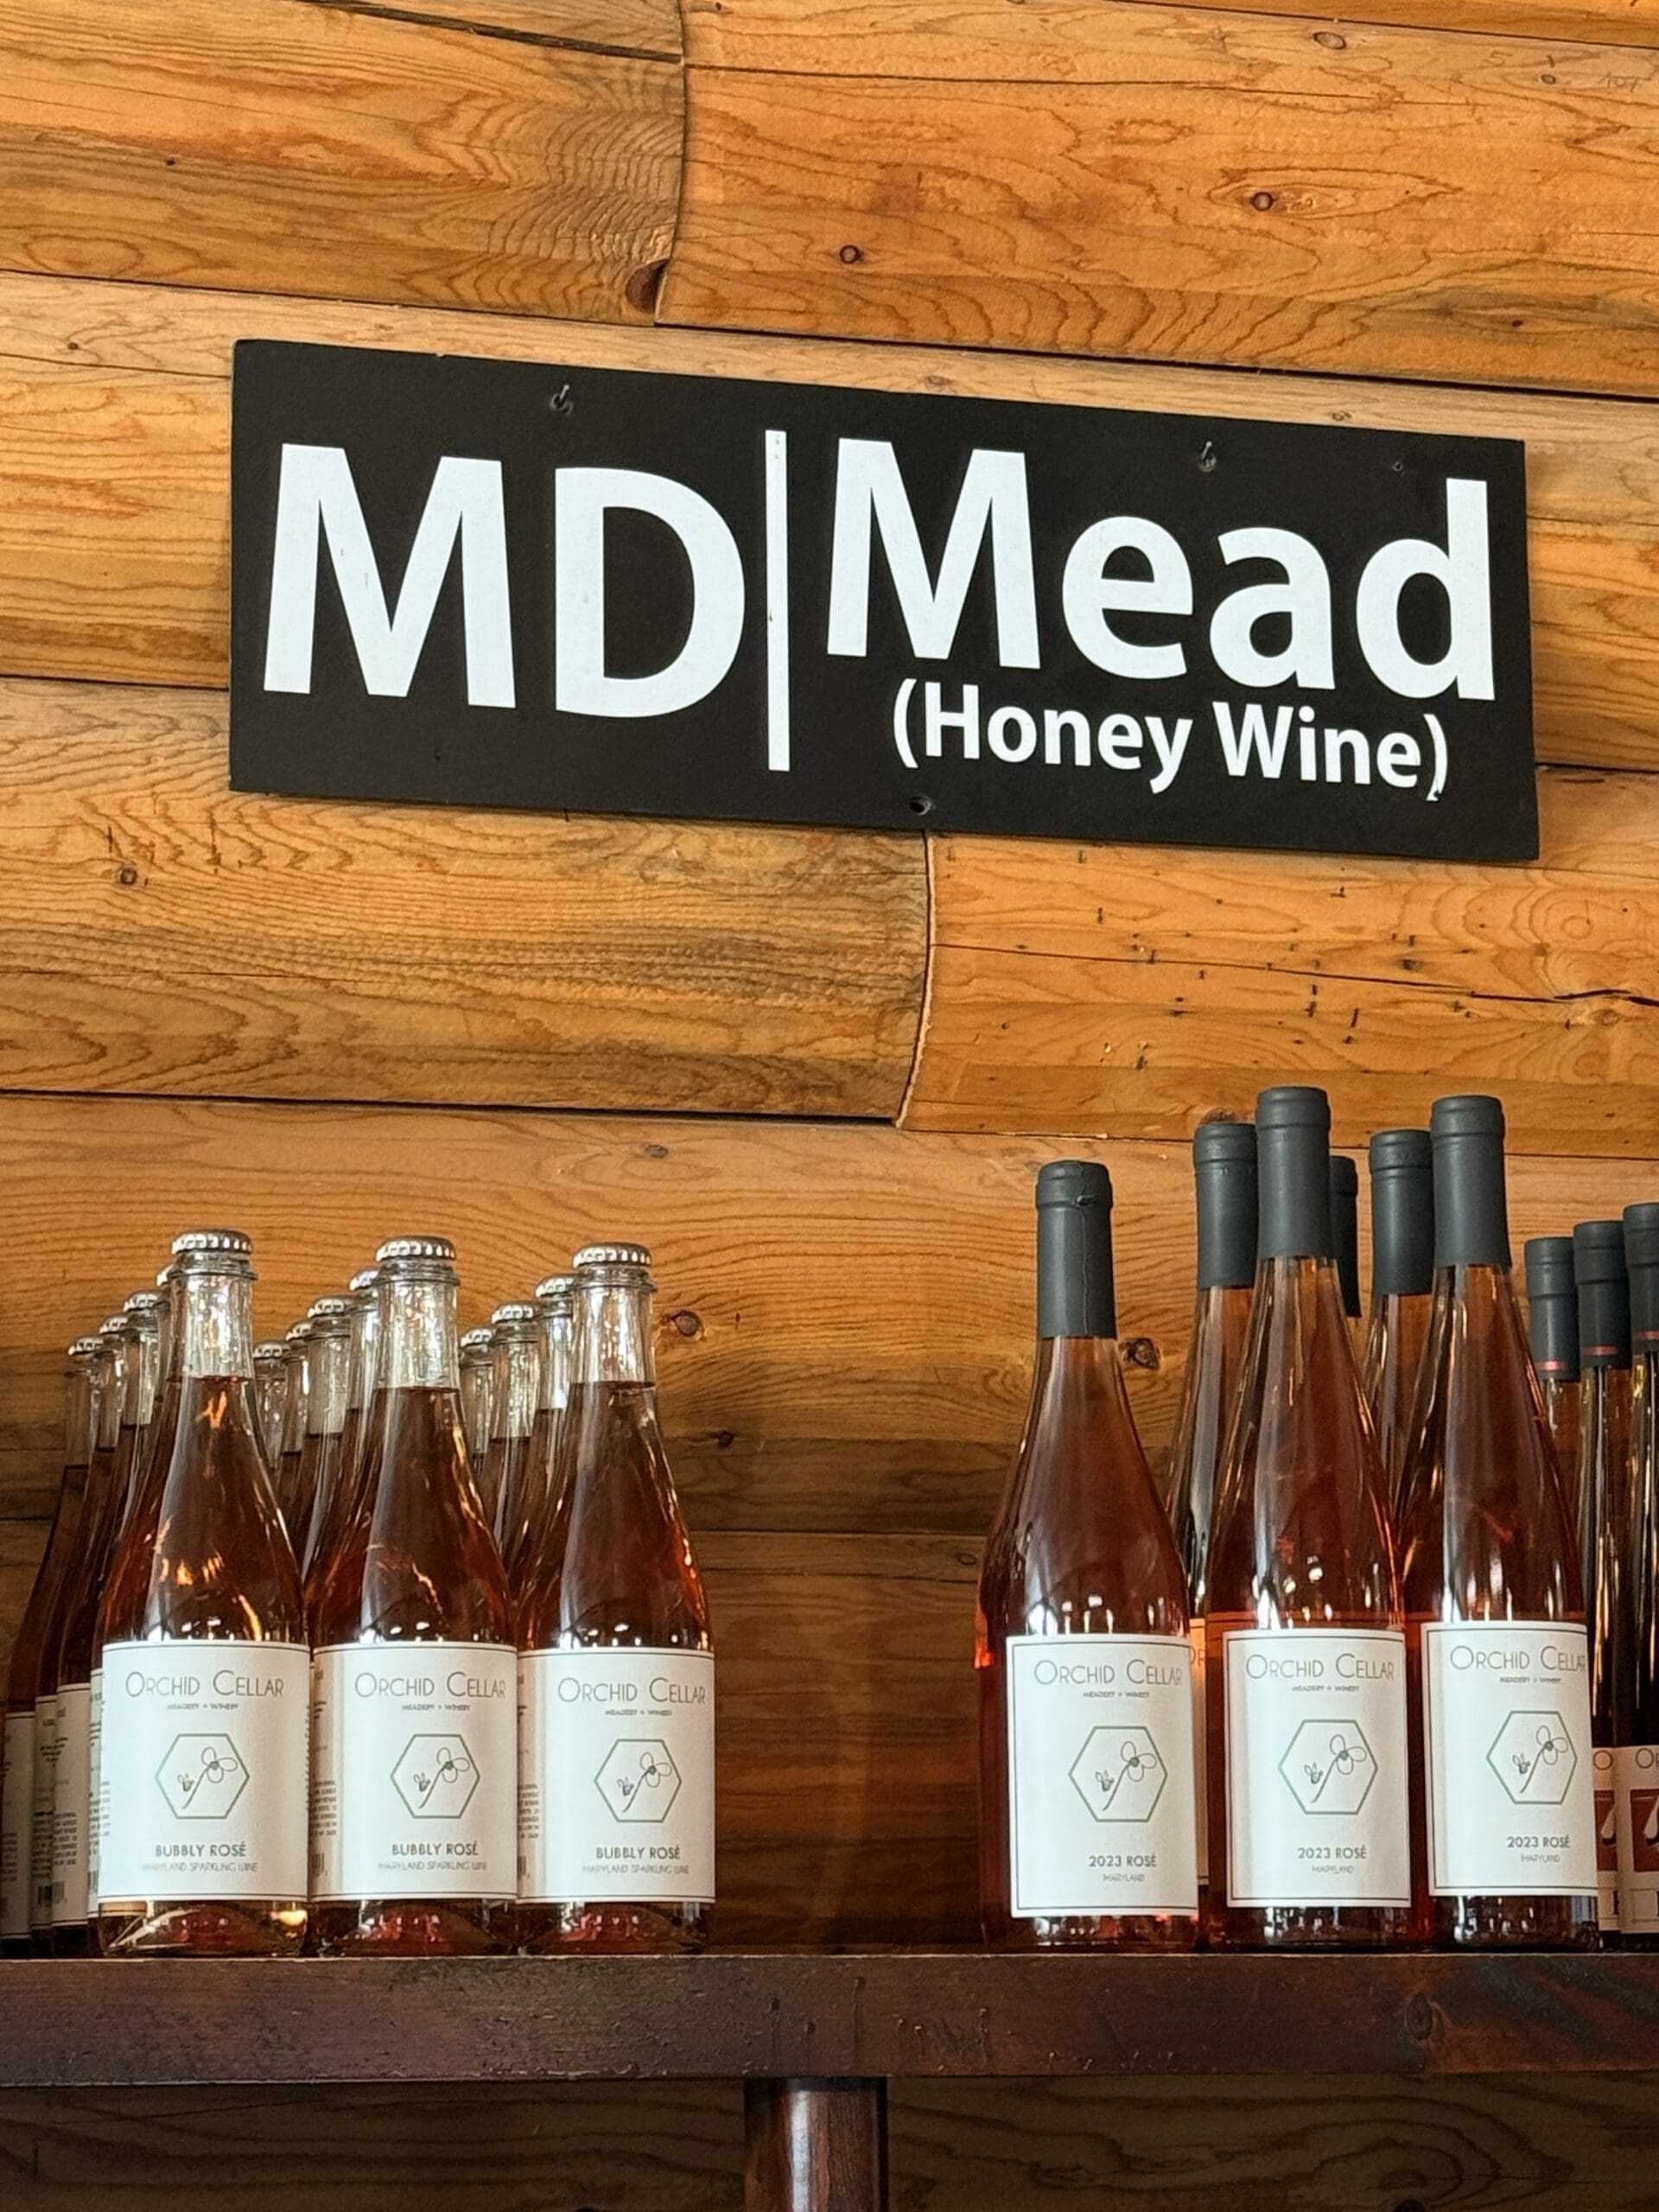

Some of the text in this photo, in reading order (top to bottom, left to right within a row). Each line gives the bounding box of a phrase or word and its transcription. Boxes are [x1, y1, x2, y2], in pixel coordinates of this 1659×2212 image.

[264, 437, 1495, 718] MD Mead
[893, 678, 1448, 804] (Honey Wine)
[1506, 1835, 1539, 1848] 2023
[155, 1843, 206, 1857] BUBBLY
[391, 1842, 442, 1856] BUBBLY
[595, 1847, 645, 1859] BUBBLY
[1297, 1847, 1331, 1859] 2023
[1088, 1854, 1122, 1867] 2023
